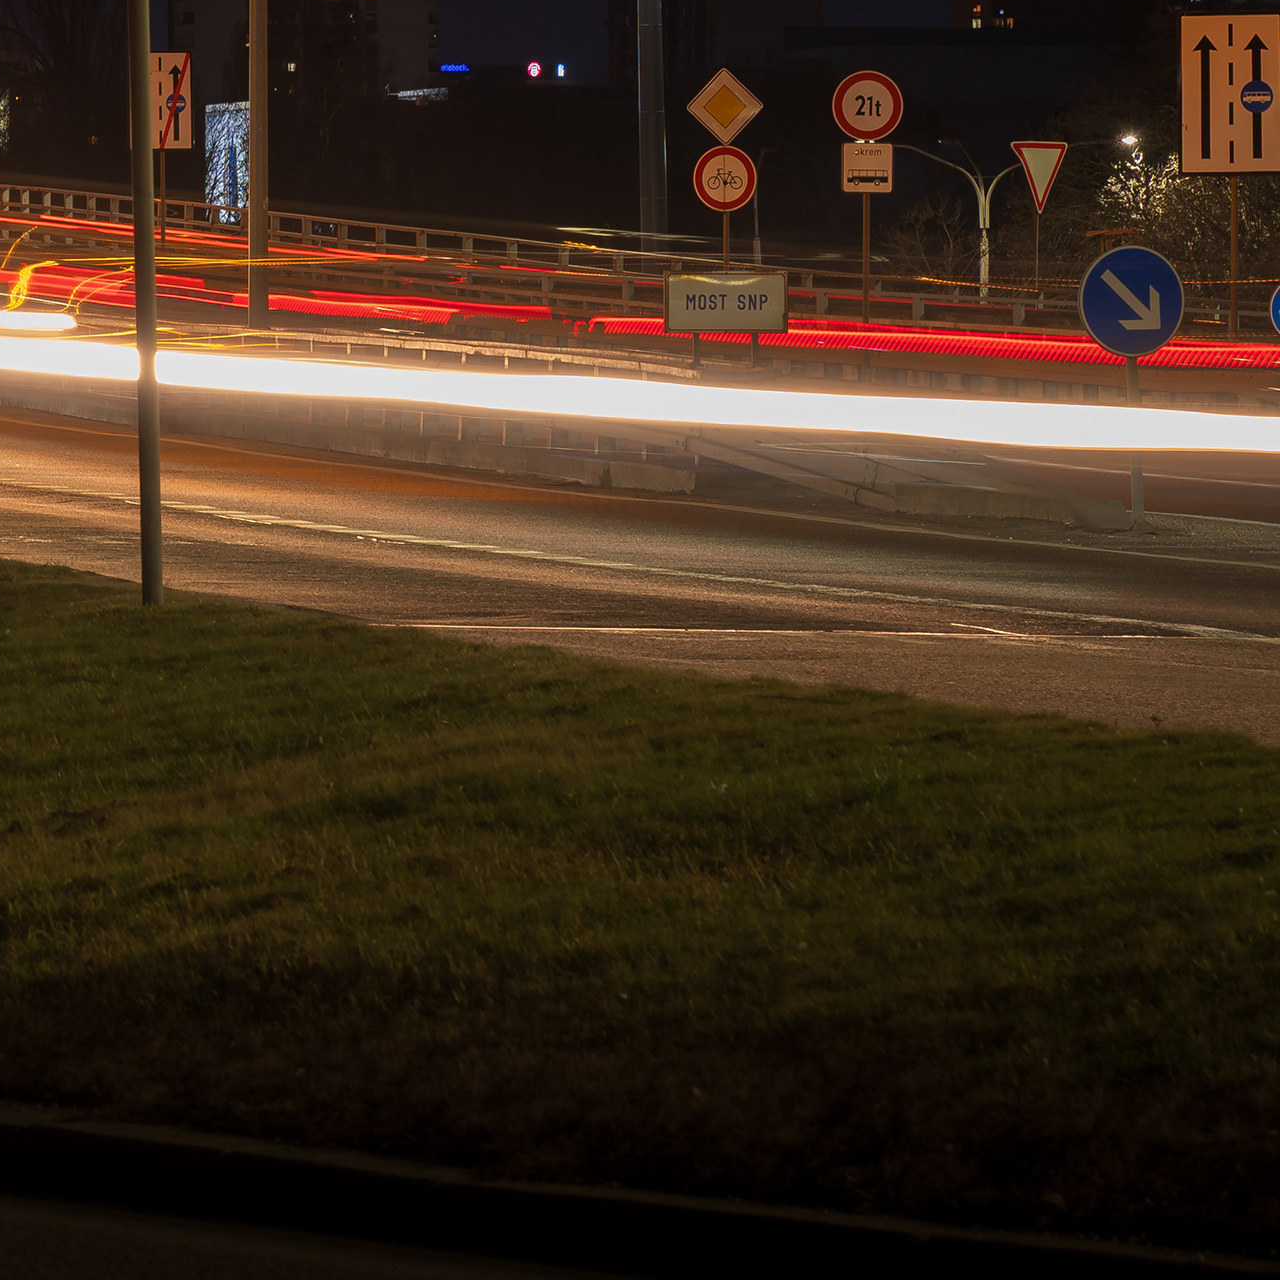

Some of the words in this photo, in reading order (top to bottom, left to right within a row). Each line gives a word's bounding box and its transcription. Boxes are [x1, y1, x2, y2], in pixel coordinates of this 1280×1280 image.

[855, 94, 882, 117] 21t
[854, 147, 882, 156] okrem
[685, 293, 728, 311] MOST
[737, 293, 769, 311] SNP
